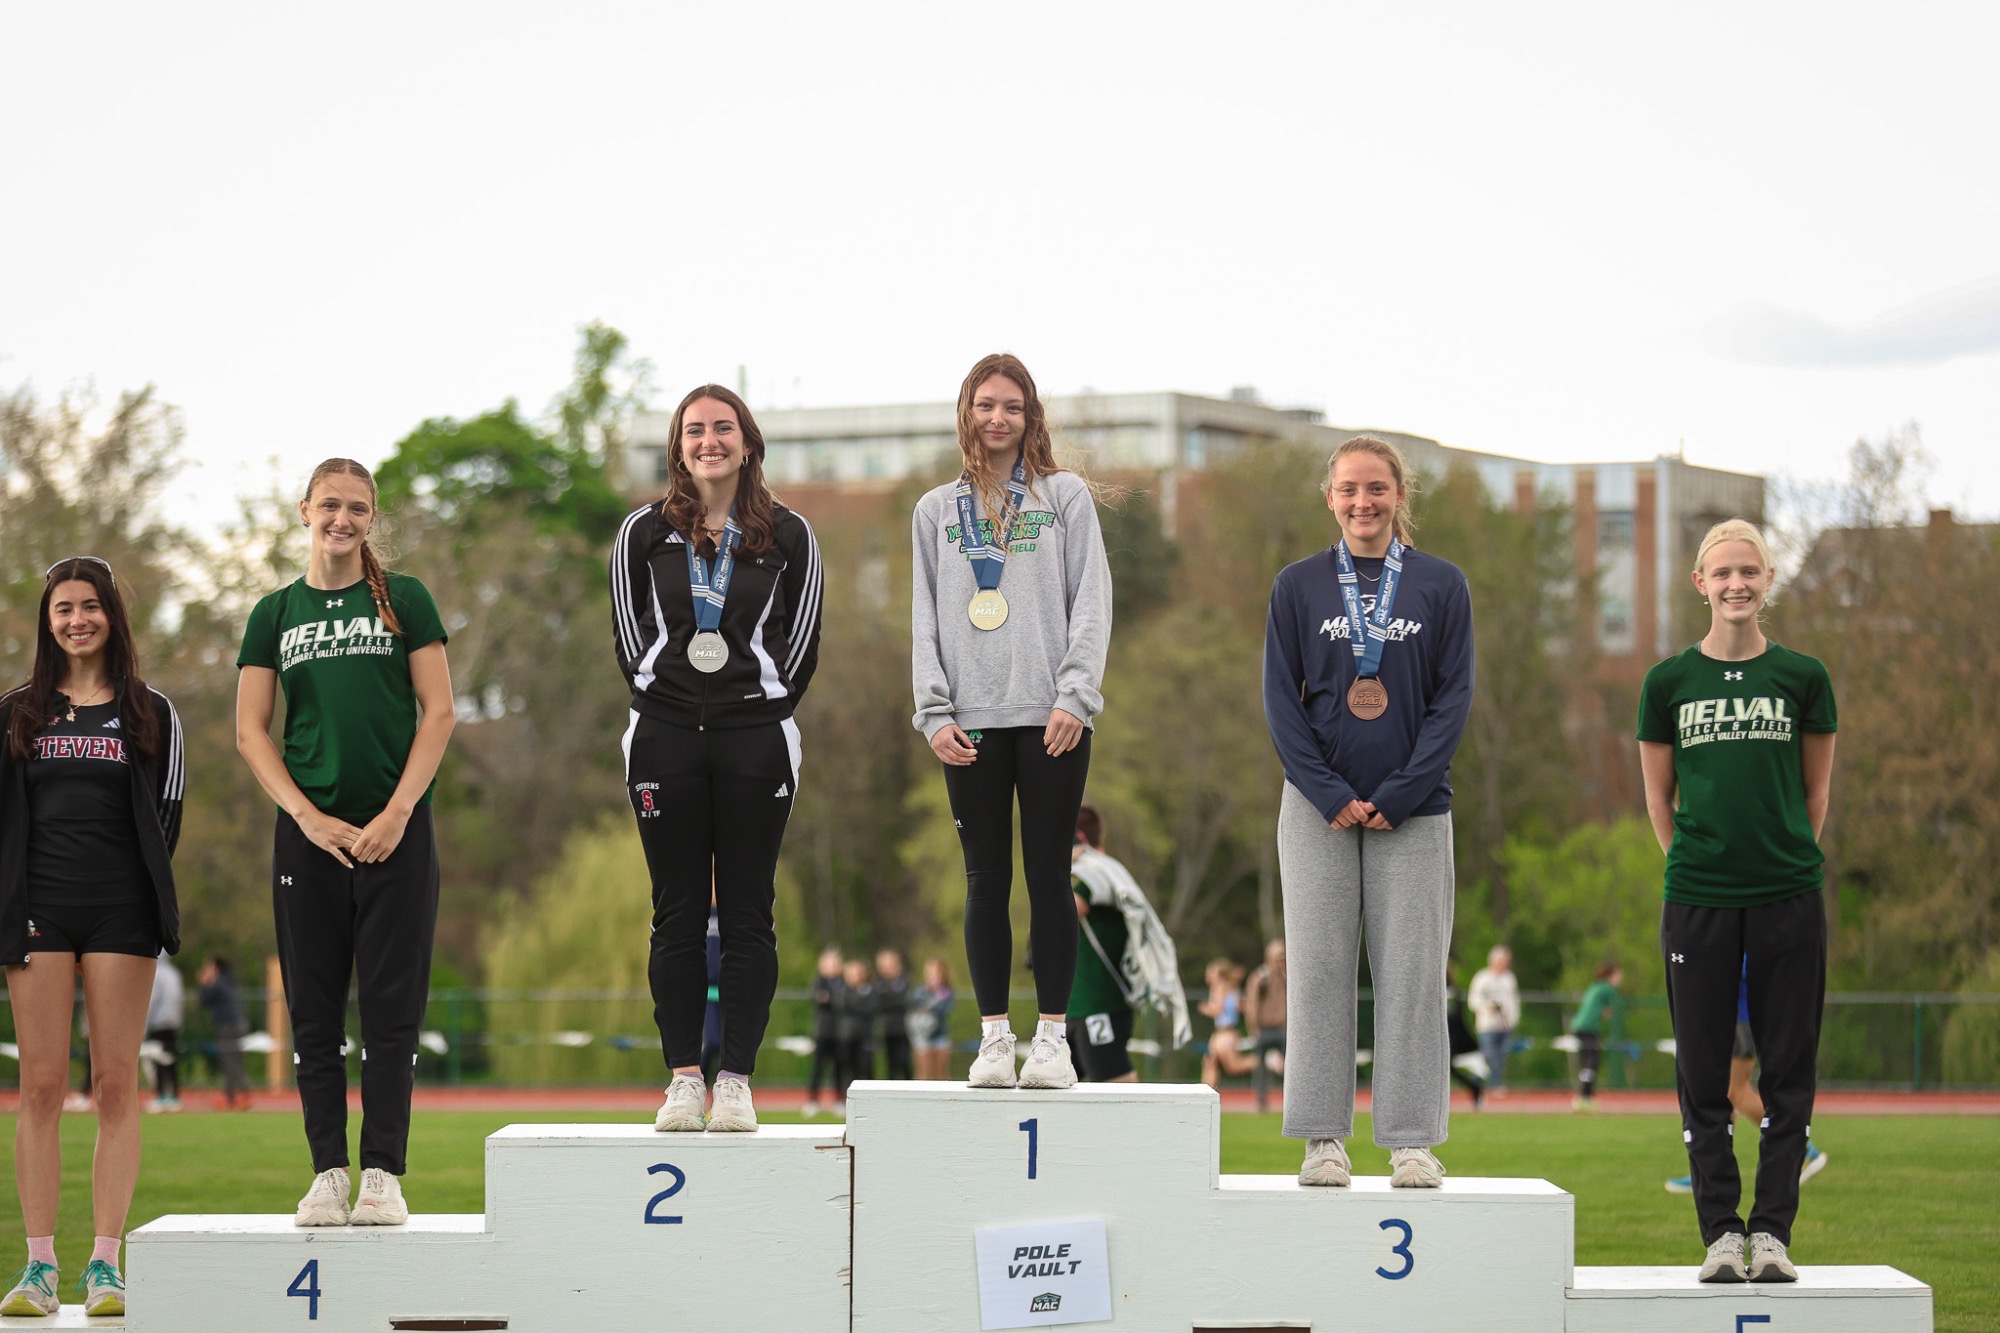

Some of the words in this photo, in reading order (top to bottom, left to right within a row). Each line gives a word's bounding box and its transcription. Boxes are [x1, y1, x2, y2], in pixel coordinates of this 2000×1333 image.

[975, 608, 1000, 616] MAC
[280, 617, 394, 654] DELVAL
[282, 642, 320, 662] TRACK
[331, 637, 338, 648] &
[350, 636, 392, 647] FIELD
[694, 650, 719, 658] MAC
[281, 651, 314, 672] DELAWARE
[316, 647, 344, 659] VALLEY
[346, 646, 394, 656] UNIVERSITY
[1353, 696, 1380, 705] MAC
[1679, 697, 1791, 730] DELVAL
[1680, 722, 1721, 739] TRACK
[1732, 721, 1740, 731] &
[1752, 720, 1791, 732] FIELD
[1681, 733, 1715, 749] DELAWARE
[1717, 730, 1747, 741] VALLEY
[1748, 730, 1792, 742] UNIVERSITY
[636, 783, 659, 792] STEVENS
[641, 790, 655, 810] S
[1019, 1118, 1038, 1180] 1
[644, 1163, 686, 1224] 2
[1014, 1244, 1071, 1261] POLE
[1375, 1218, 1414, 1280] 3
[1007, 1260, 1082, 1279] VAULT
[287, 1259, 321, 1320] 4
[1033, 1302, 1058, 1311] MAC
